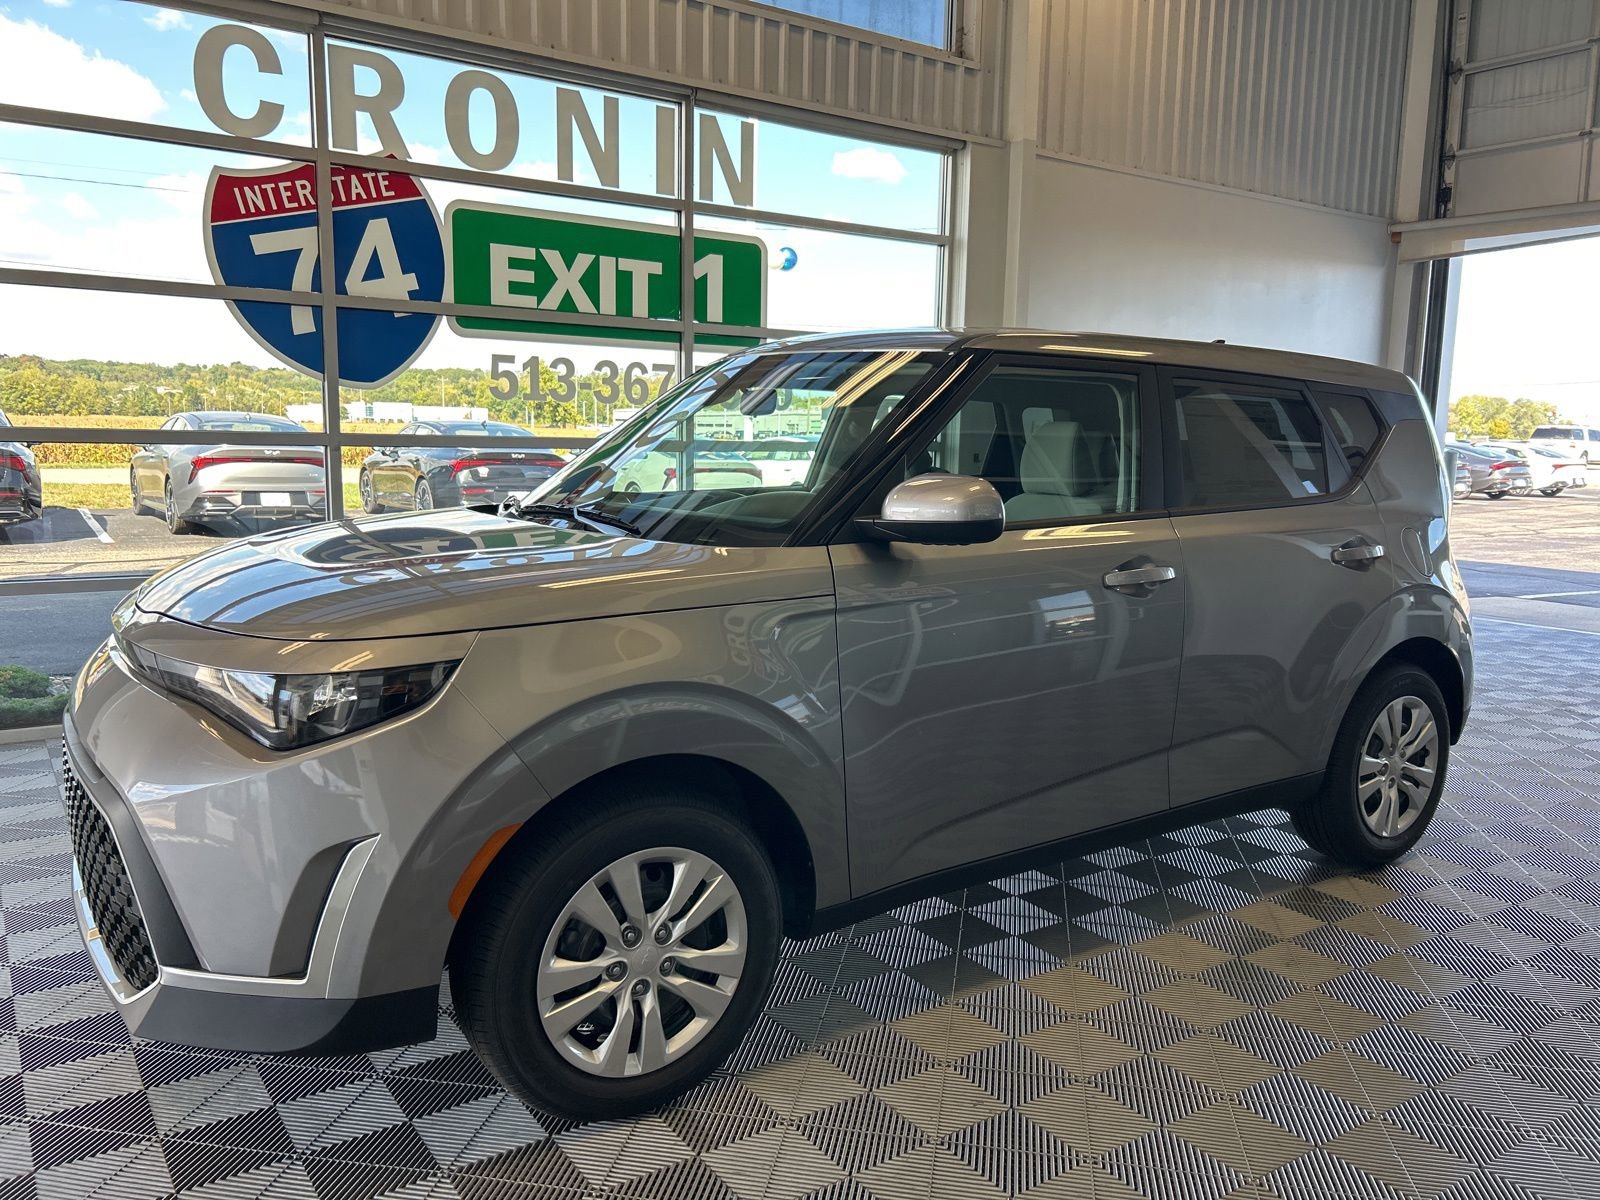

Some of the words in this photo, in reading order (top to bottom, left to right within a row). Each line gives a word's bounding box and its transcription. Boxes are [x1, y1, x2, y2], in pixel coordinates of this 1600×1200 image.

[193, 24, 755, 207] CRONIN
[234, 172, 395, 214] INTERTATE
[250, 217, 419, 335] 74
[489, 243, 662, 318] EXIT
[694, 254, 724, 322] 1
